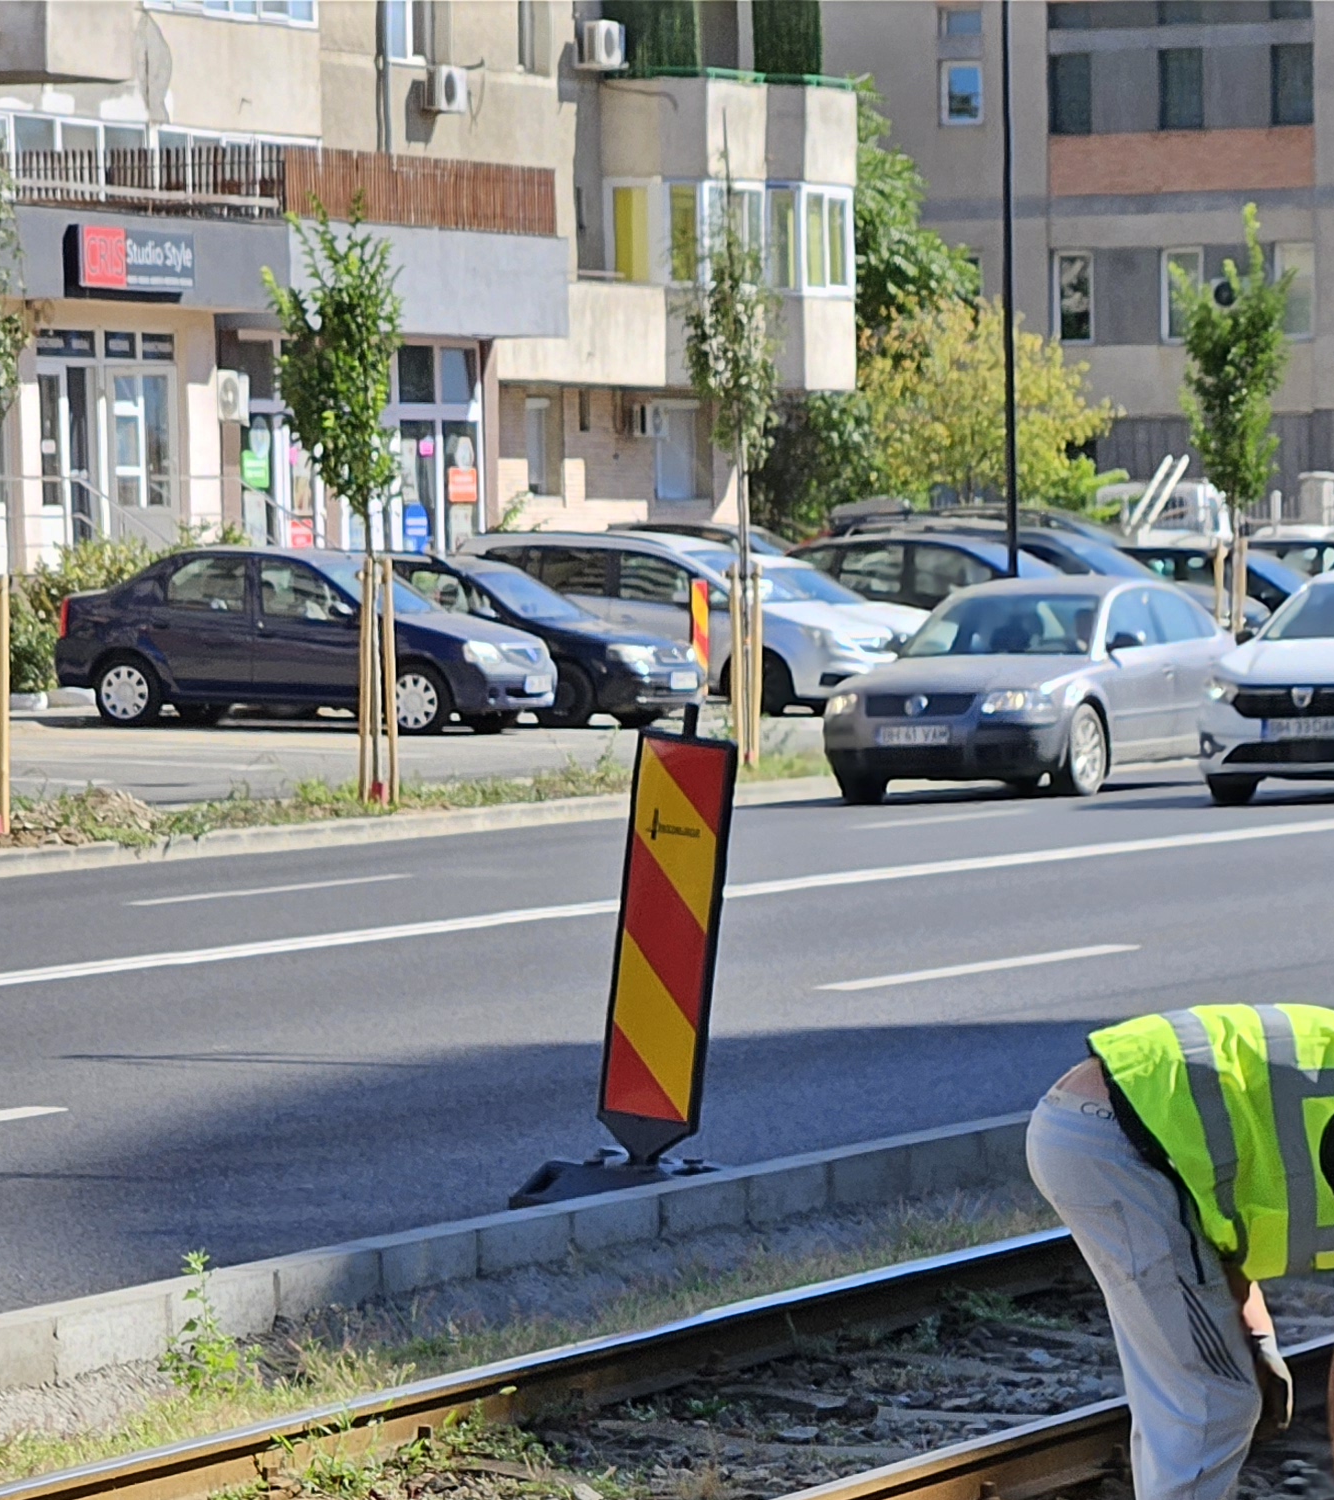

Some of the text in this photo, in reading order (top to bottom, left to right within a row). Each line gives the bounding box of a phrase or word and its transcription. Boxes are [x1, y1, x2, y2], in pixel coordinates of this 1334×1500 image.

[87, 237, 193, 276] CRIS Studio Style
